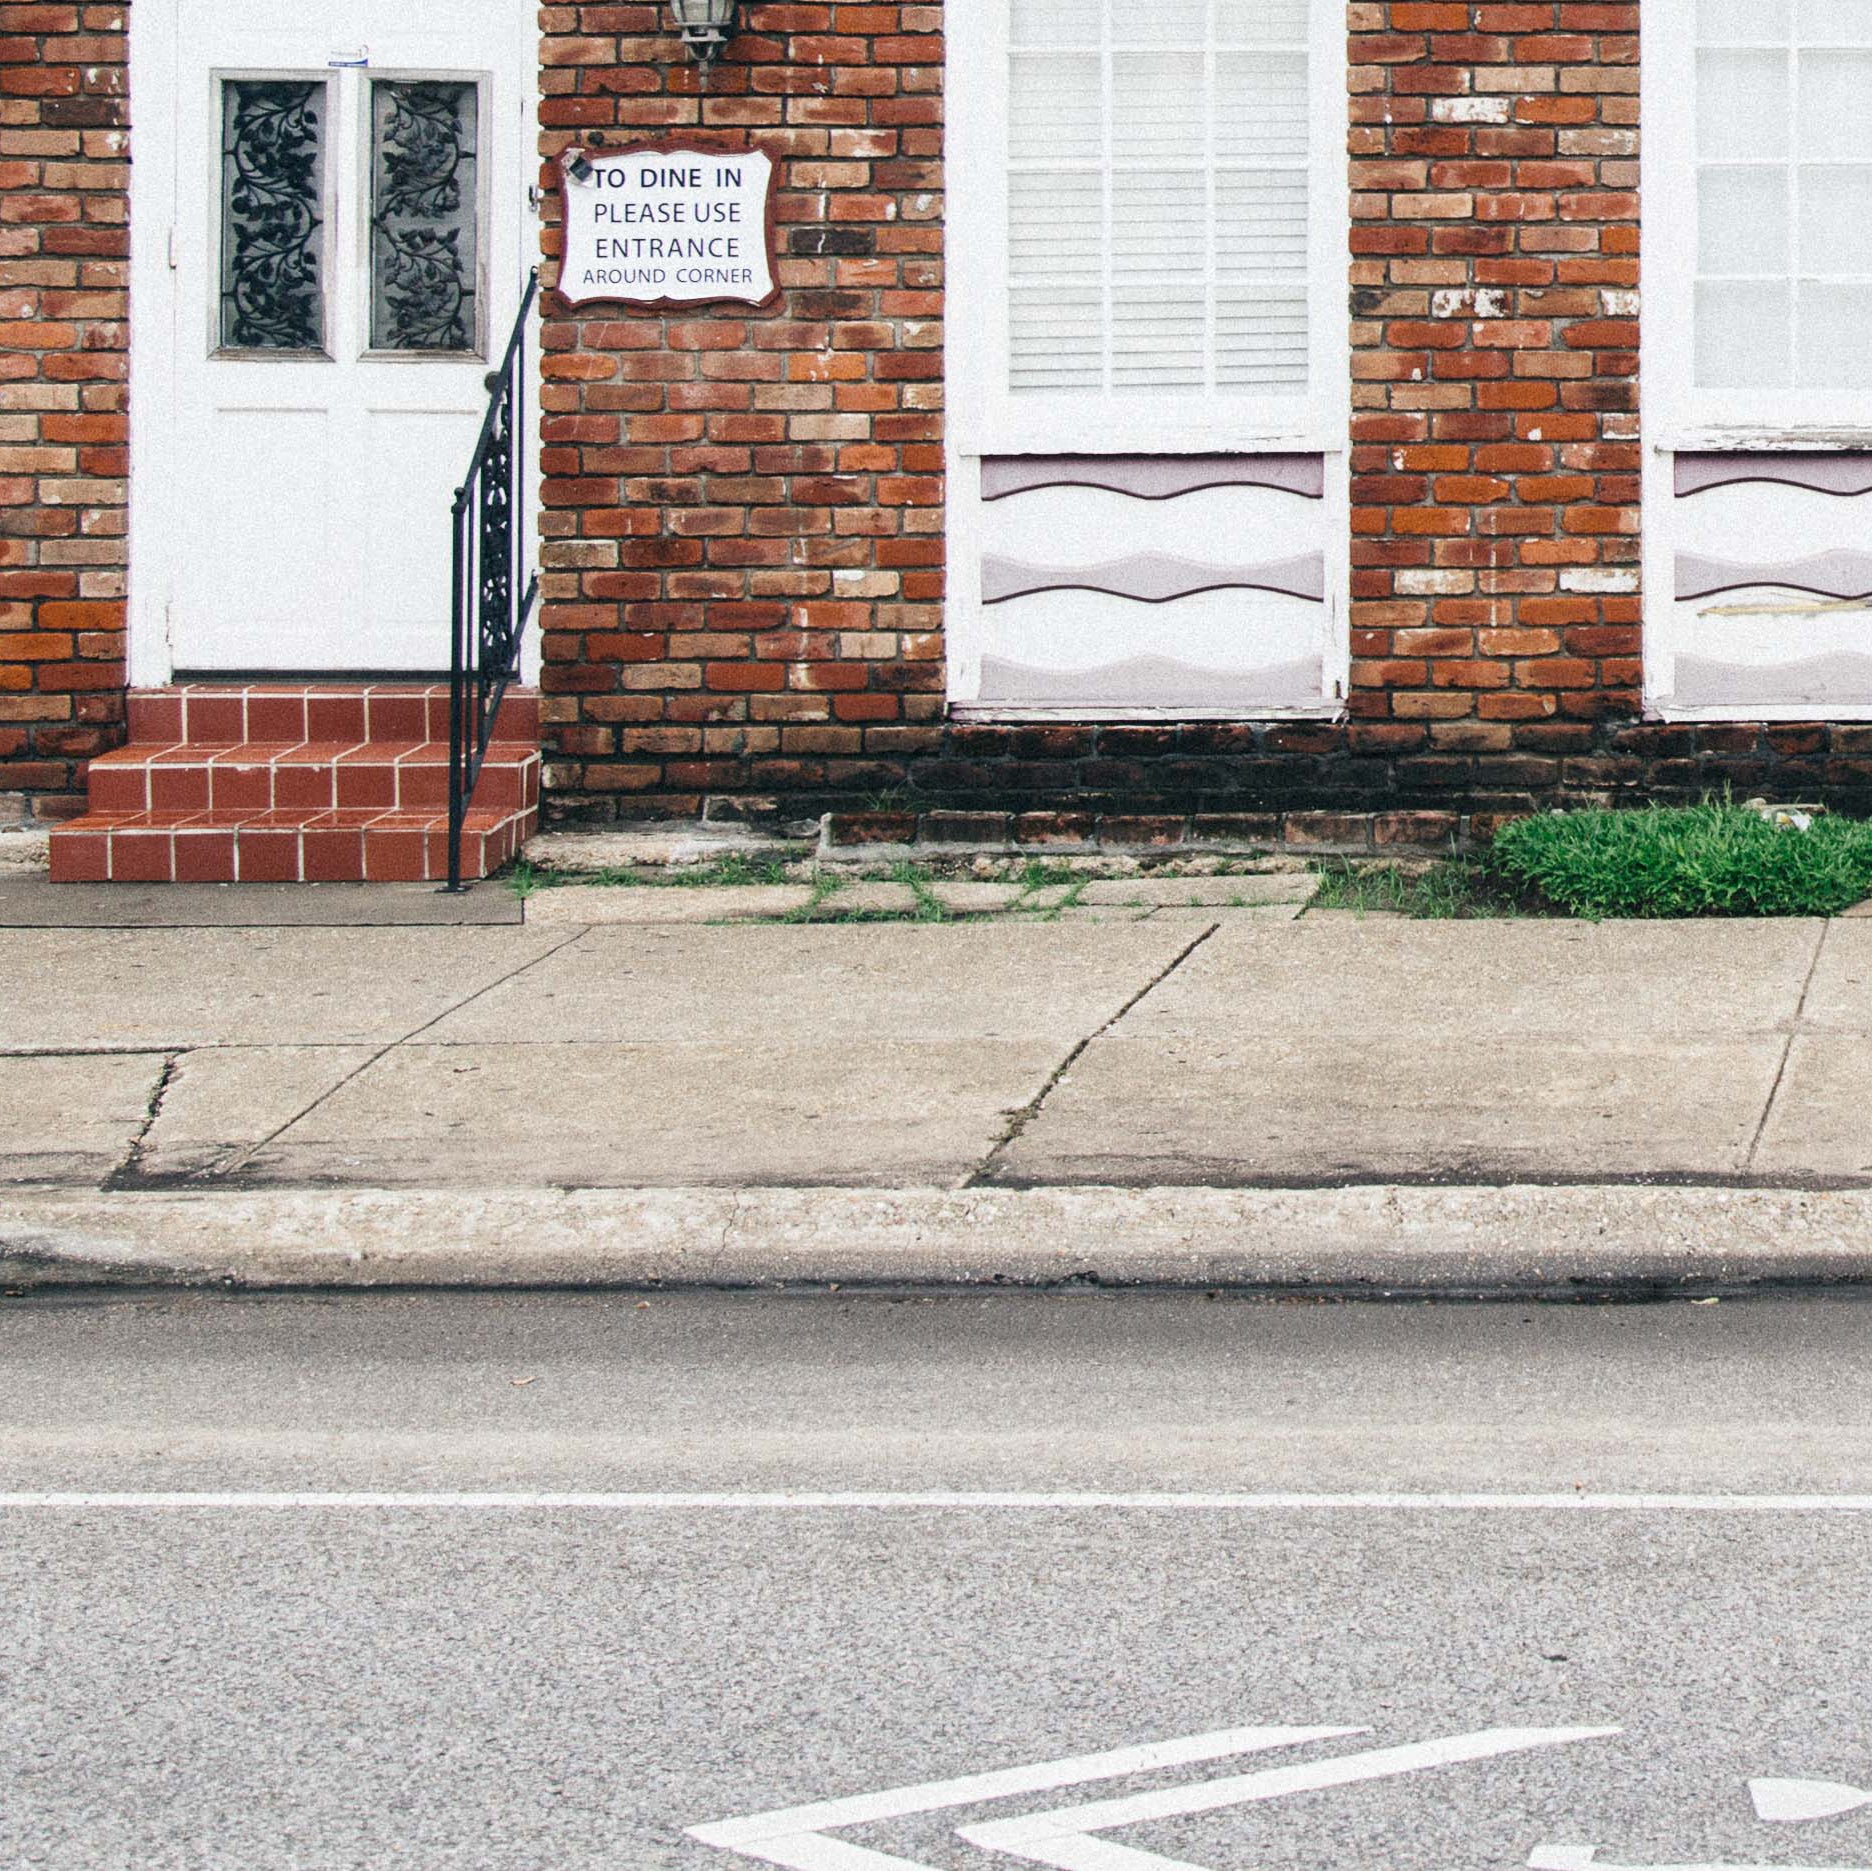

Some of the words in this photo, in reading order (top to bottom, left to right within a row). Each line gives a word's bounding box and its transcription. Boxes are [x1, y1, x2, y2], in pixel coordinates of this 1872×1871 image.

[594, 168, 626, 189] TO
[640, 168, 702, 188] DINE
[716, 168, 742, 188] IN
[594, 202, 685, 224] PLEASE
[694, 202, 741, 223] USE
[595, 237, 740, 259] ENTRANCE
[583, 268, 666, 284] AROUND
[676, 268, 752, 284] CORNER
